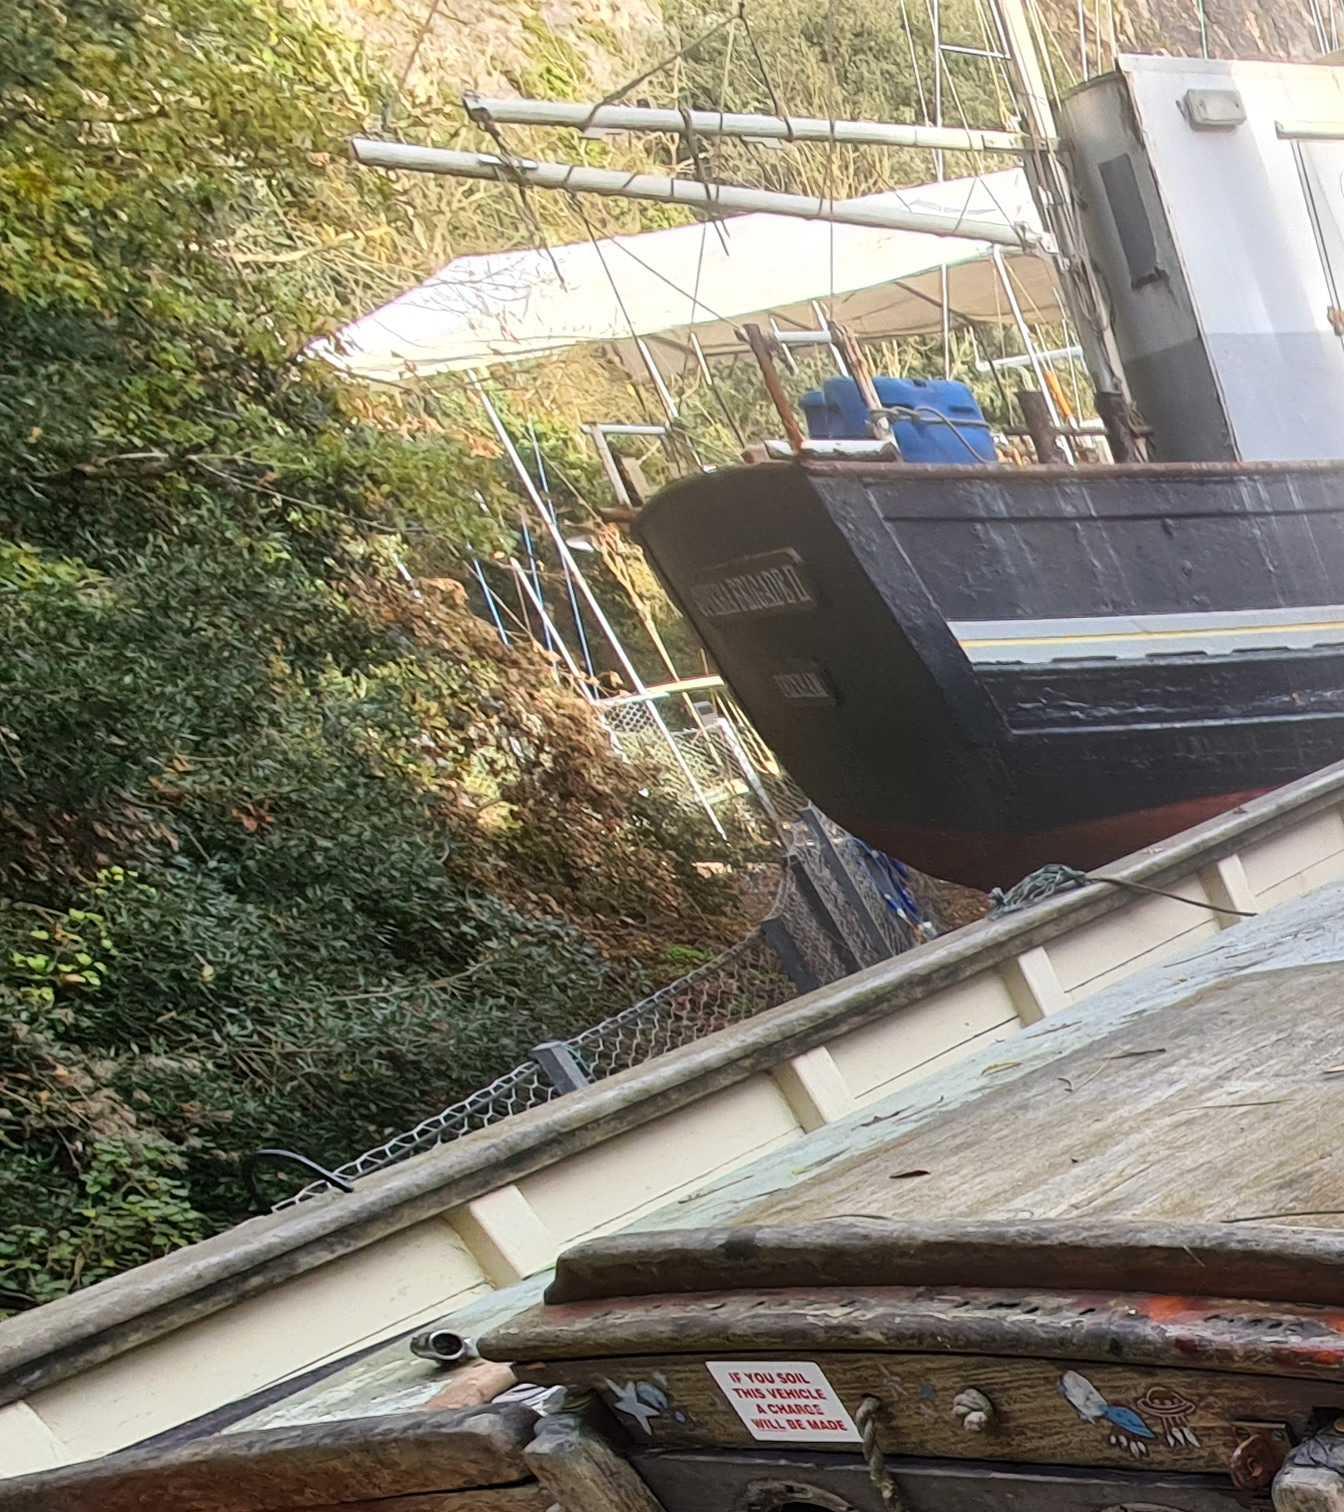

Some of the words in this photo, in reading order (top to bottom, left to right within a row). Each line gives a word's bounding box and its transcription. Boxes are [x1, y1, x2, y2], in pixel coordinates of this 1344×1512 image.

[728, 1372, 742, 1384] IF
[743, 1372, 775, 1385] YOU
[776, 1373, 811, 1385] SOIL
[732, 1388, 766, 1400] THIS
[766, 1388, 827, 1400] VEHICLE
[755, 1403, 767, 1415] A
[767, 1404, 825, 1416] CHARGE
[751, 1419, 786, 1431] WILL
[785, 1419, 807, 1431] BE
[807, 1419, 848, 1432] MADE
